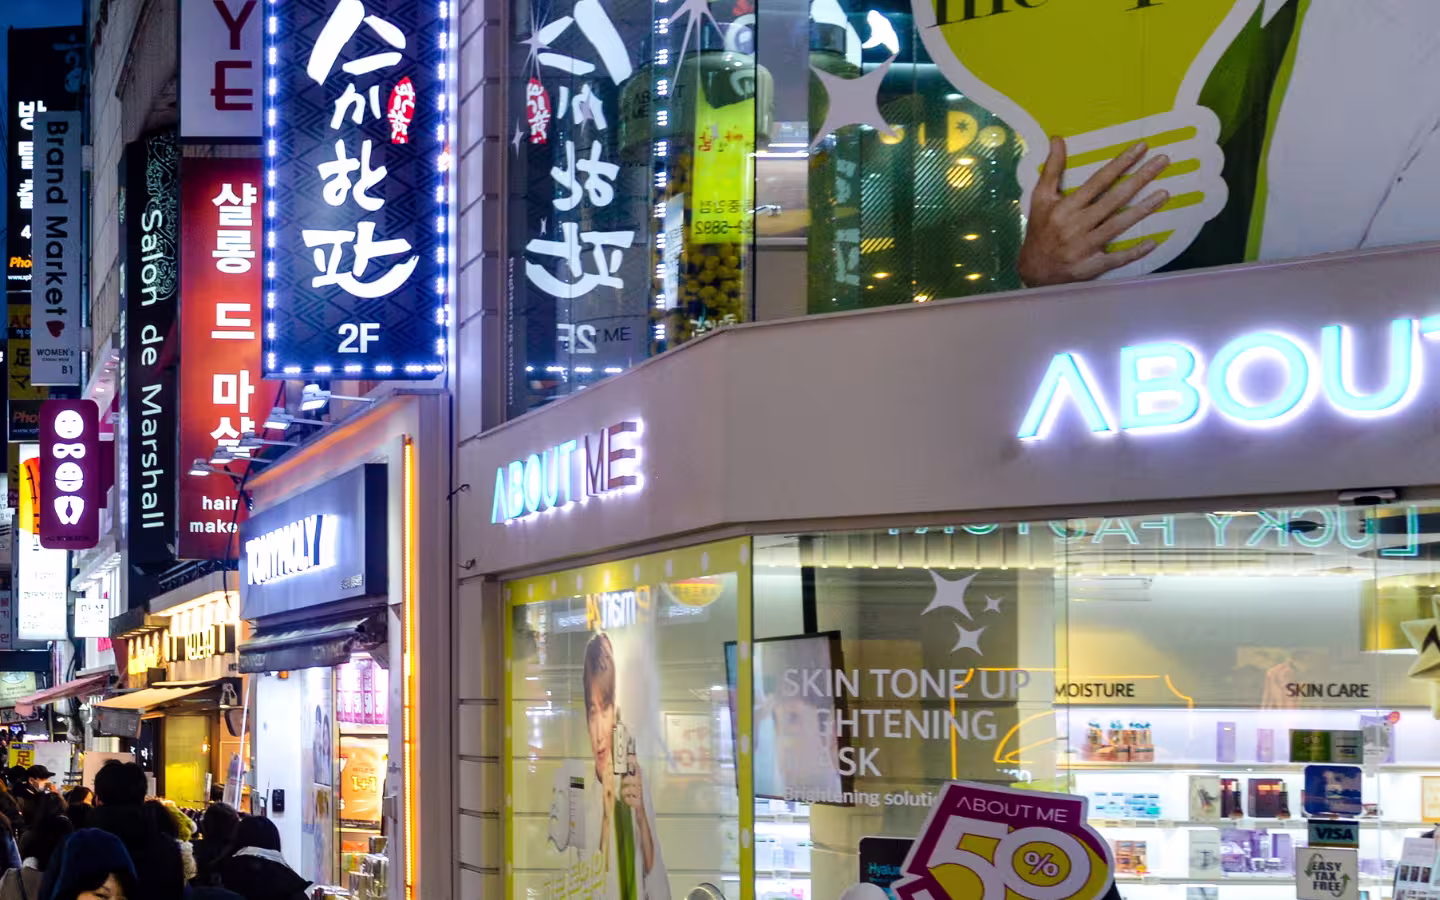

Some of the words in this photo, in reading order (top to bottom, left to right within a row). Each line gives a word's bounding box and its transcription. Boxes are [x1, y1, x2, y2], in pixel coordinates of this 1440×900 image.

[46, 121, 68, 204] Brand
[211, 183, 257, 274] 샬롱
[45, 216, 68, 316] Market
[141, 209, 163, 306] Salon
[211, 302, 255, 340] 드
[141, 324, 164, 366] de
[337, 322, 380, 353] 2F
[62, 366, 73, 374] B1
[1017, 316, 1440, 440] ABOU
[141, 383, 164, 528] Marshall
[491, 439, 577, 524] ABOUT
[585, 420, 643, 497] ME
[202, 496, 238, 510] hair
[780, 669, 859, 698] SKIN
[870, 669, 968, 699] TONE
[980, 669, 1031, 700] UP
[1056, 683, 1135, 698] MOISTURE
[1286, 683, 1322, 698] SKIN
[1326, 683, 1369, 698] CARE
[810, 709, 998, 741] GHTENING
[956, 796, 1033, 819] ABOUT
[1036, 807, 1068, 824] ME
[1315, 827, 1354, 841] VISA
[1311, 862, 1342, 871] EASY
[1315, 872, 1337, 881] TAX
[1313, 881, 1341, 891] FREE
